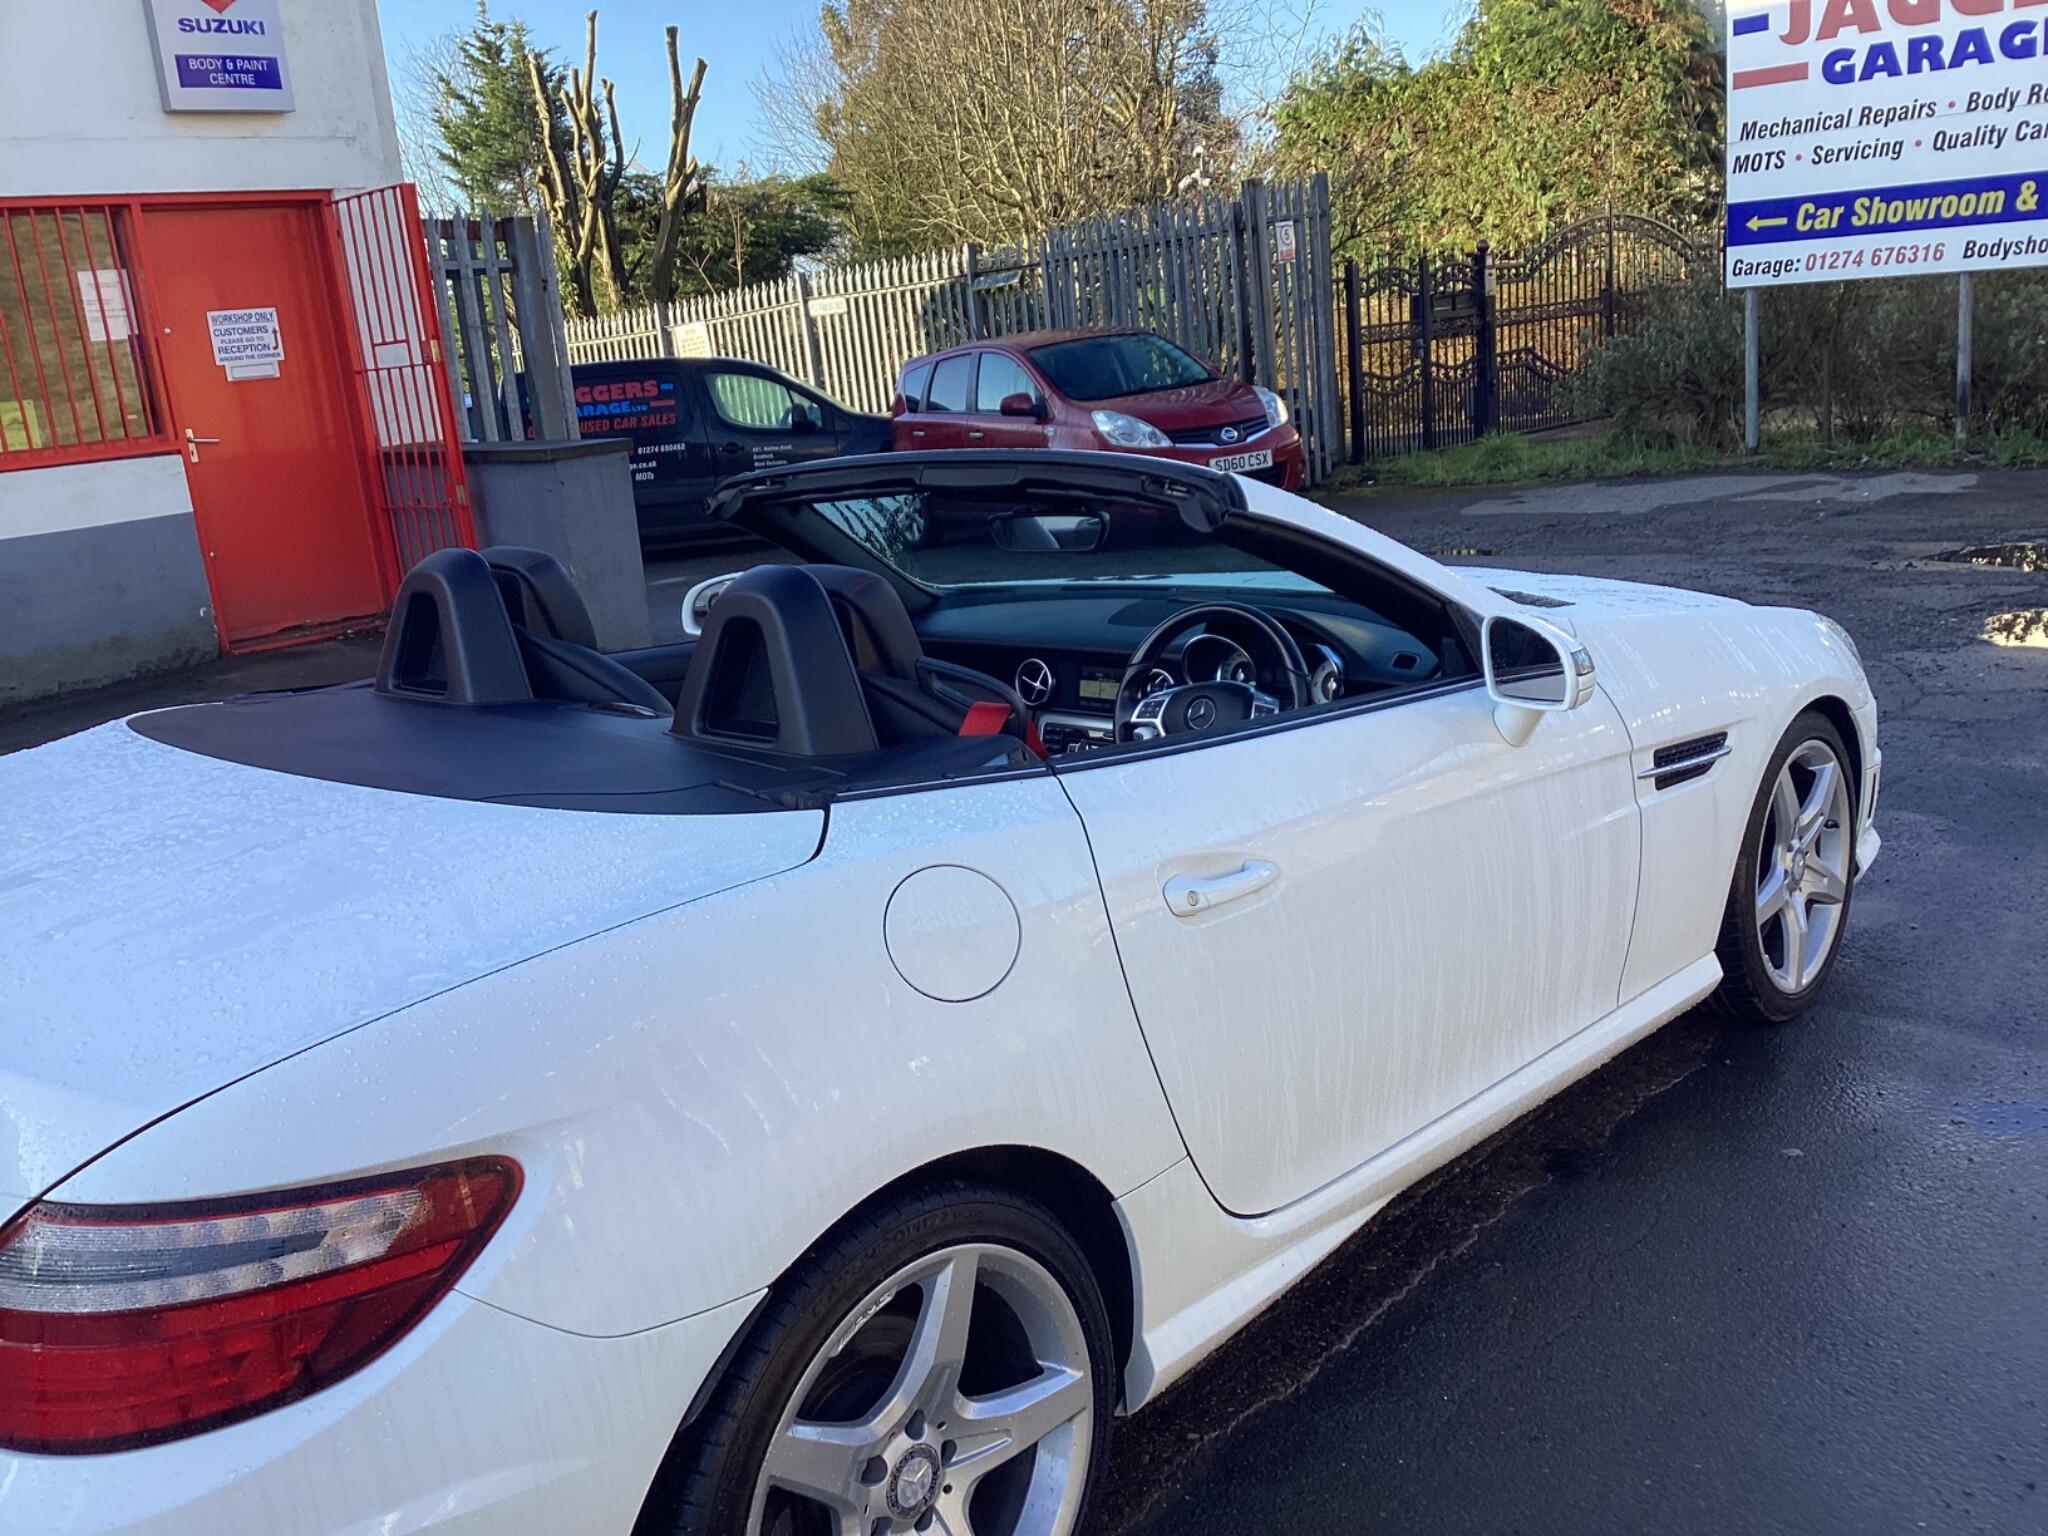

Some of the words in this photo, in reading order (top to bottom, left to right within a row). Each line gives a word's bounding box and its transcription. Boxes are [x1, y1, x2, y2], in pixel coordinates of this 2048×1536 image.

[178, 18, 265, 35] SUZUKI
[1822, 17, 2048, 85] GARAG
[188, 58, 223, 70] BODY
[226, 59, 233, 70] &
[236, 59, 268, 71] PAINT
[209, 73, 256, 85] CENTRE
[1739, 107, 1853, 142] Mechanical
[1858, 98, 1937, 128] Repairs
[1966, 86, 2021, 112] Body
[1732, 149, 1787, 174] MOTS
[1811, 138, 1904, 165] Servicing
[1933, 124, 2008, 152] Quality
[1796, 202, 1845, 232] Car
[1851, 190, 2006, 227] Showroom
[2016, 180, 2039, 211] &
[1732, 257, 1801, 278] Garage:
[1804, 249, 1865, 272] 01274
[1870, 242, 1946, 267] 676316
[1963, 235, 2048, 261] Bodysho
[210, 312, 253, 324] WORKSHOP
[254, 311, 273, 321] ONLY
[213, 325, 269, 337] CUSTOMERS
[217, 343, 271, 354] RECEPTION
[580, 419, 609, 433] USED
[614, 416, 637, 430] CAR
[640, 413, 677, 427] SALES
[1215, 456, 1245, 472] SD60
[1248, 452, 1268, 467] CSX
